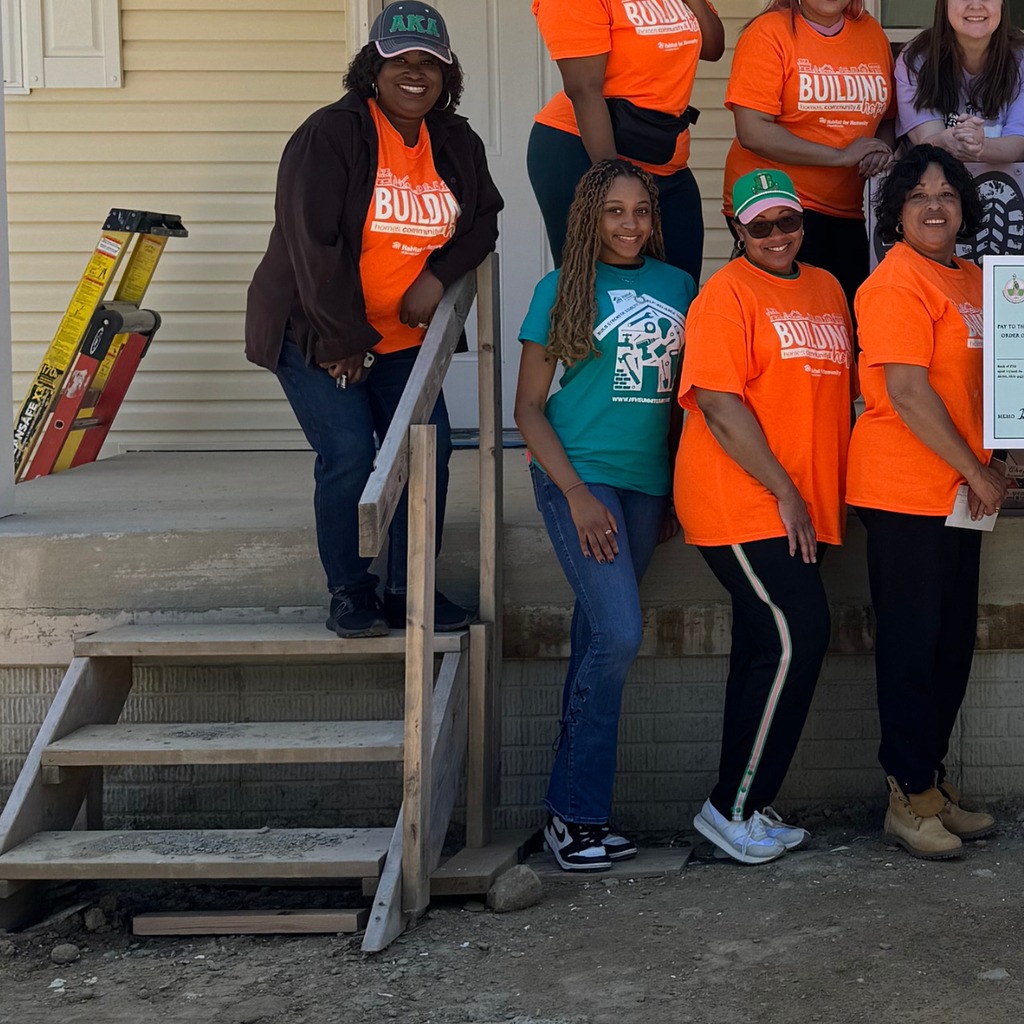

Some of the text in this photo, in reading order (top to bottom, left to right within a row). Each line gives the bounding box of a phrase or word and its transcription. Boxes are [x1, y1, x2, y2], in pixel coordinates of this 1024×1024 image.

[389, 14, 440, 37] AKA
[799, 74, 889, 103] BUILDING
[375, 187, 462, 225] BUILDIN
